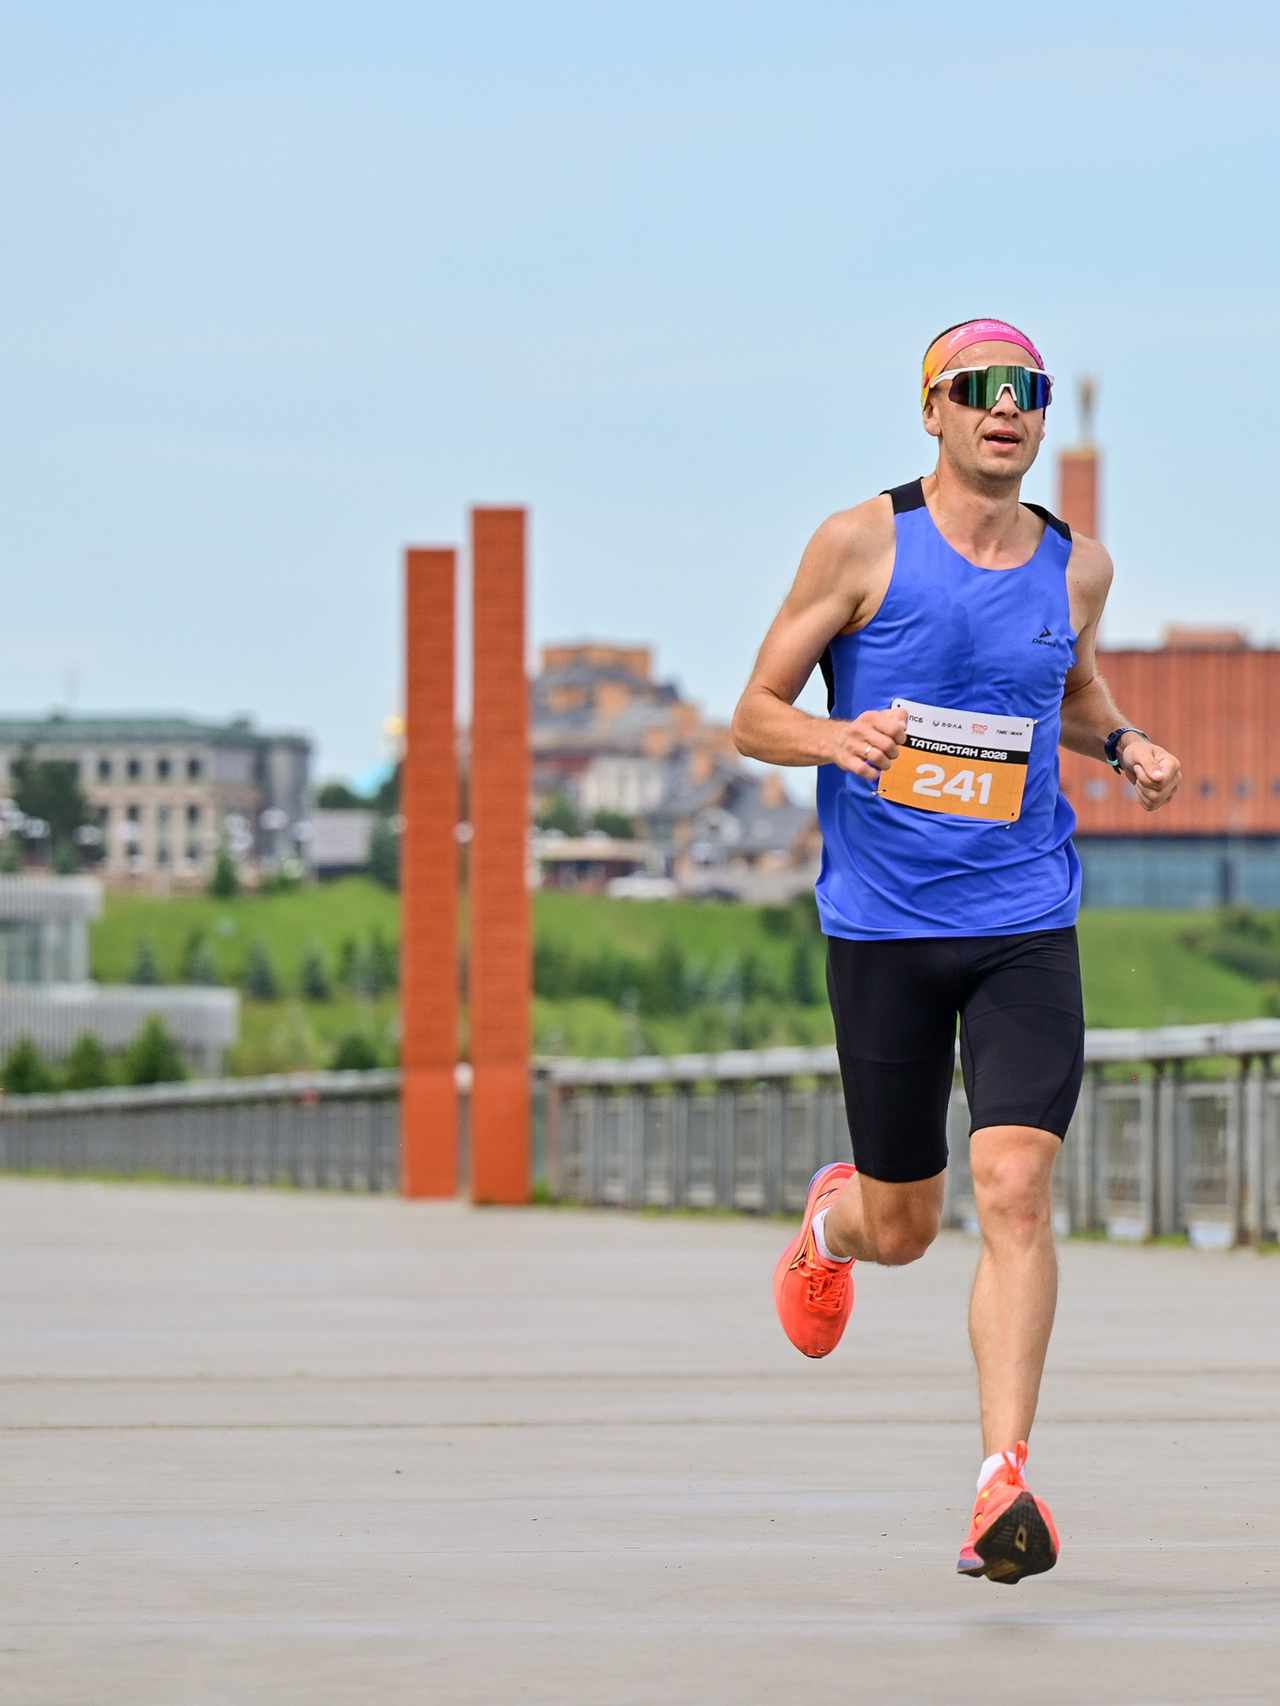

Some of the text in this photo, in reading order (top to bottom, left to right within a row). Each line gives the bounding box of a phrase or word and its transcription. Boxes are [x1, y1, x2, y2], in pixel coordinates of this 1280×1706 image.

[909, 715, 923, 723] ПСБ
[909, 737, 1008, 761] ТАТАРСТАН 2026
[912, 763, 993, 805] 241
